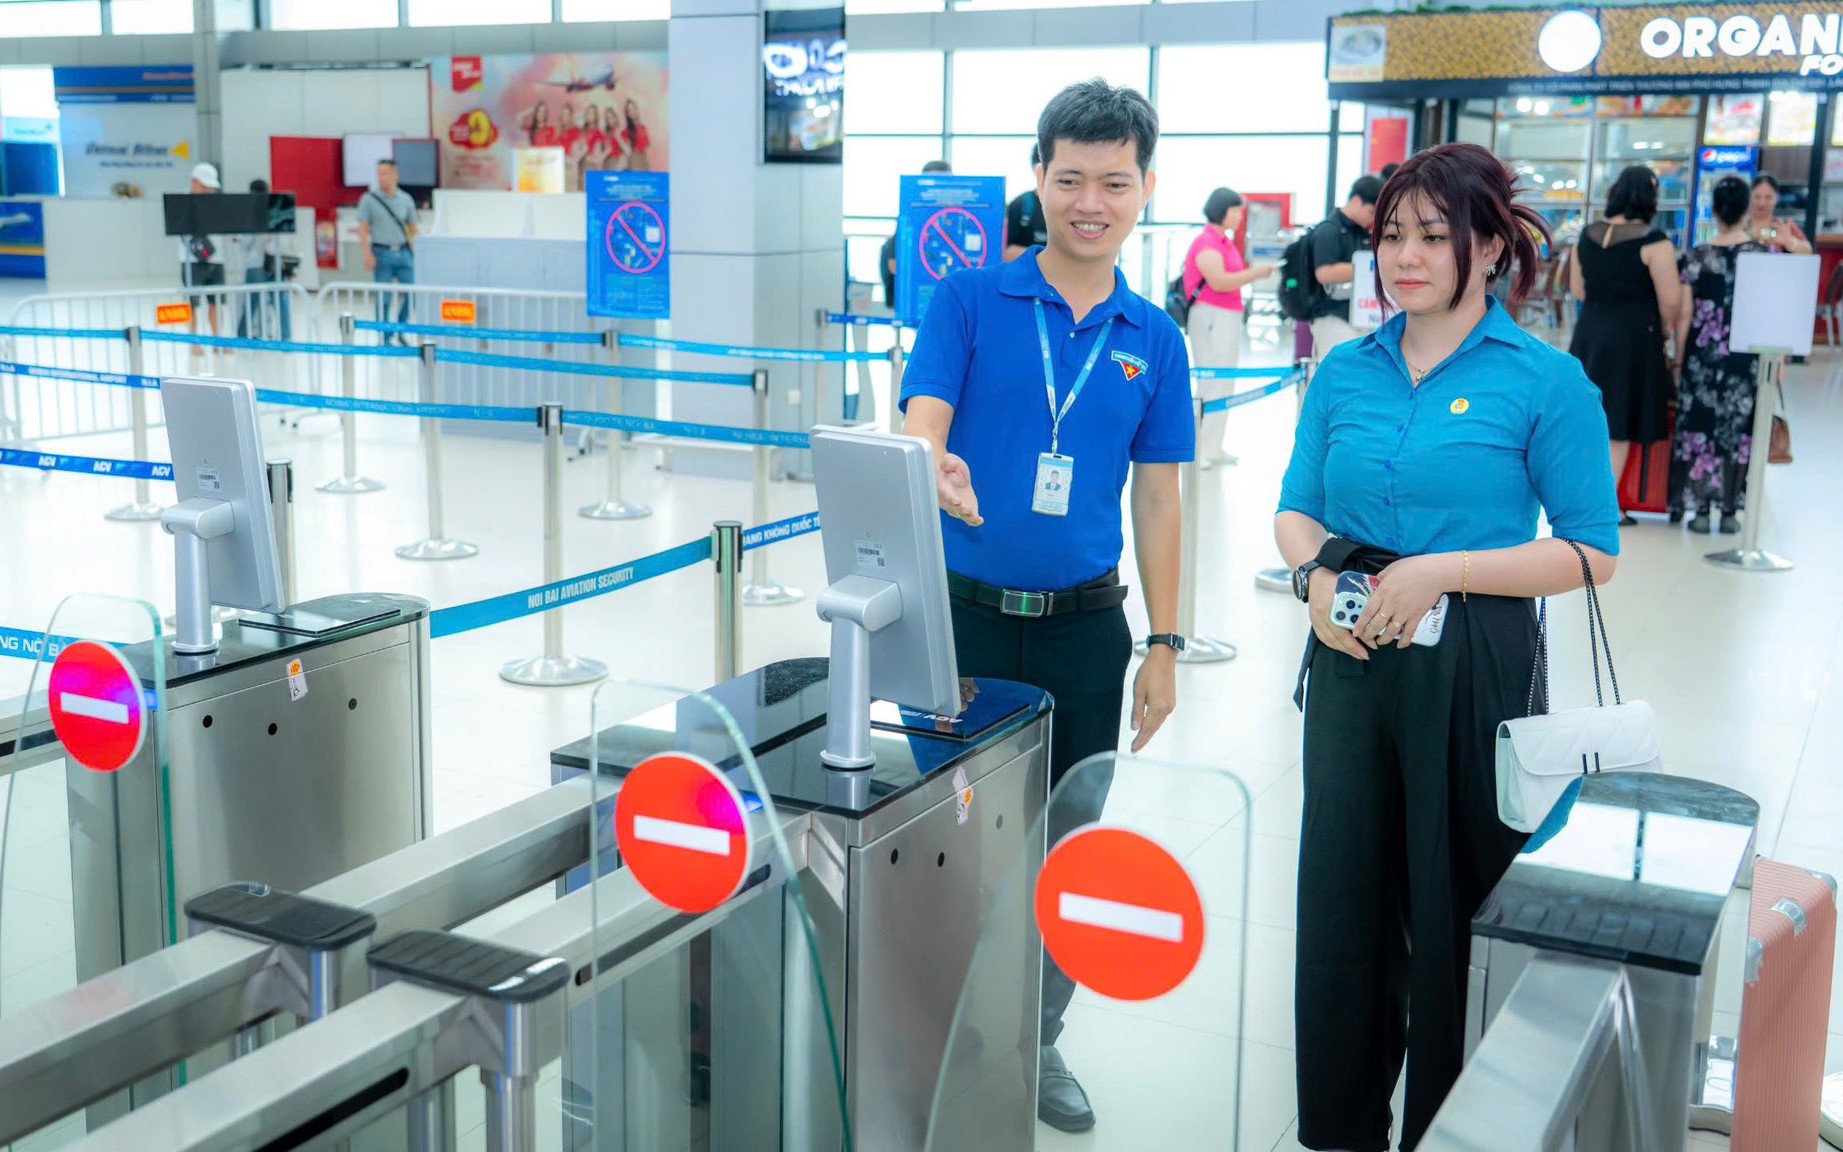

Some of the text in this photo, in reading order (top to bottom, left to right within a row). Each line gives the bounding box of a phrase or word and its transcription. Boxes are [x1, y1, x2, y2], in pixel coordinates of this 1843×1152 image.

[1641, 14, 1843, 58] ORGAN
[528, 566, 634, 608] NOI BAI AVIATION SECURITY
